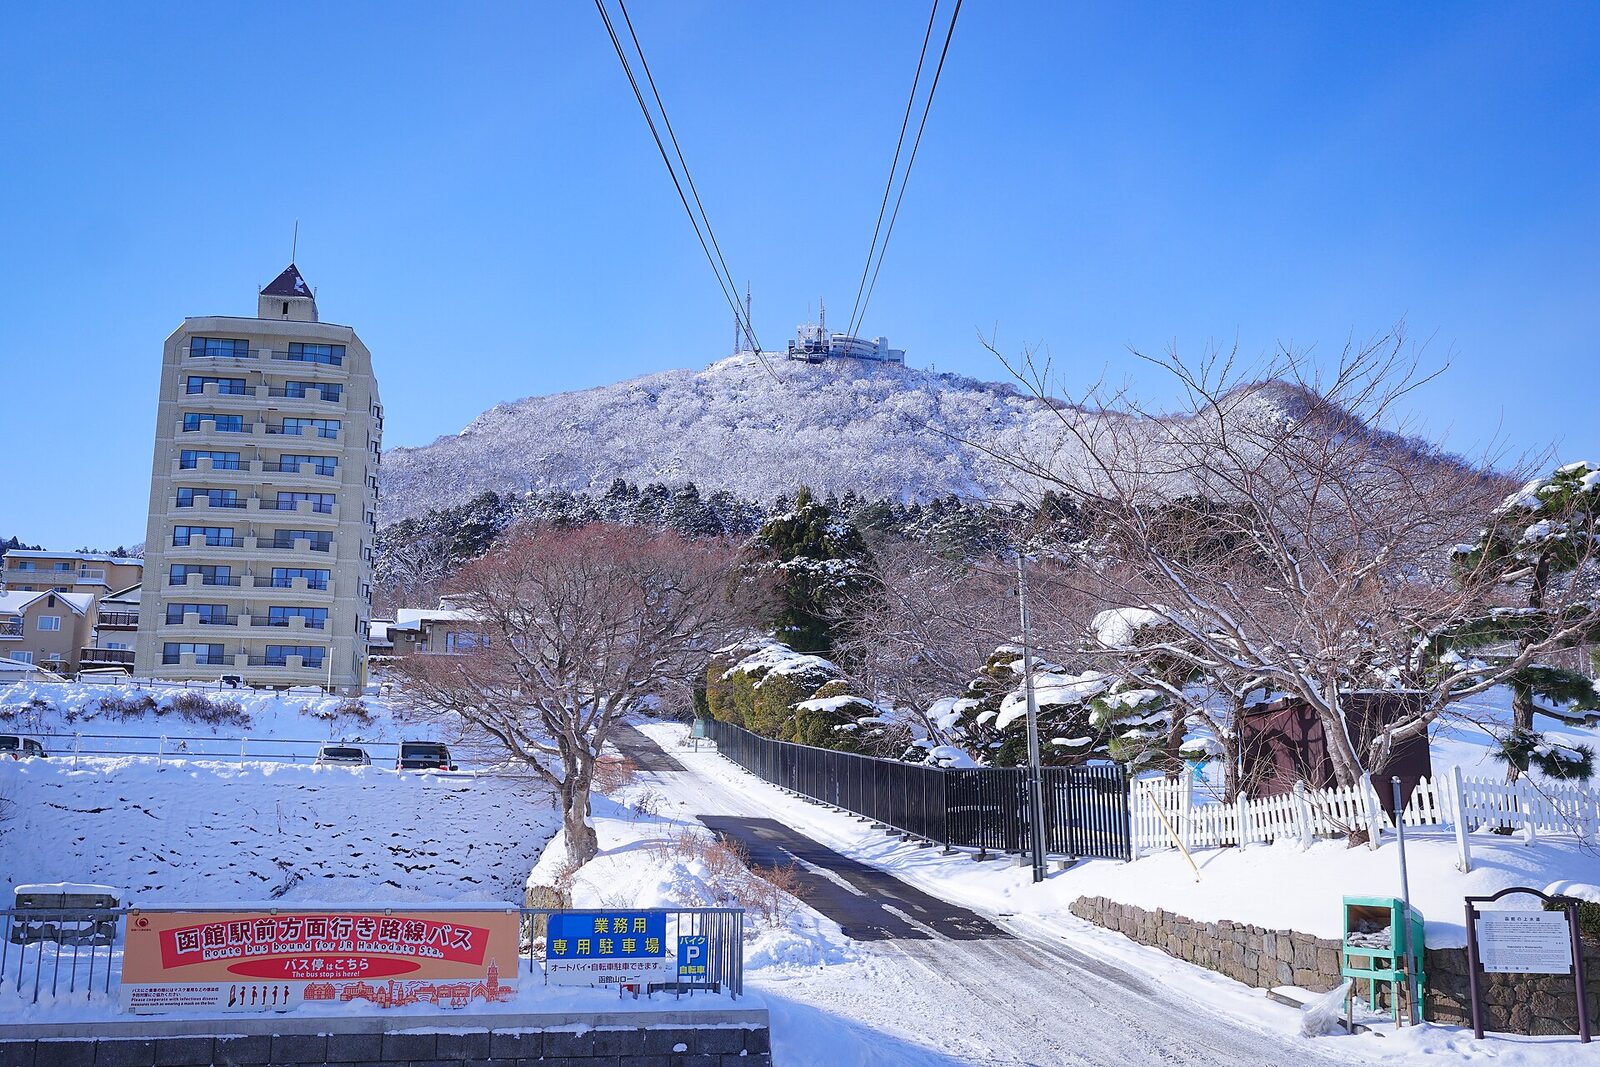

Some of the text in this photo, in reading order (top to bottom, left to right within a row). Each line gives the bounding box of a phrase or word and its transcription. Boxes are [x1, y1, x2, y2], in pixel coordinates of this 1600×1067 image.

[594, 917, 647, 934] 業務用
[176, 916, 473, 953] 函館駅前方面行き路線バス
[680, 937, 705, 945] バイク
[204, 940, 443, 958] Route bus bound for JR Hakodate Sta.
[552, 938, 660, 955] 専用駐車場
[687, 946, 700, 964] P
[284, 958, 369, 970] バス停はこちら
[551, 962, 662, 971] オートバイ・自転車駐車できます。
[680, 965, 705, 974] 自転車
